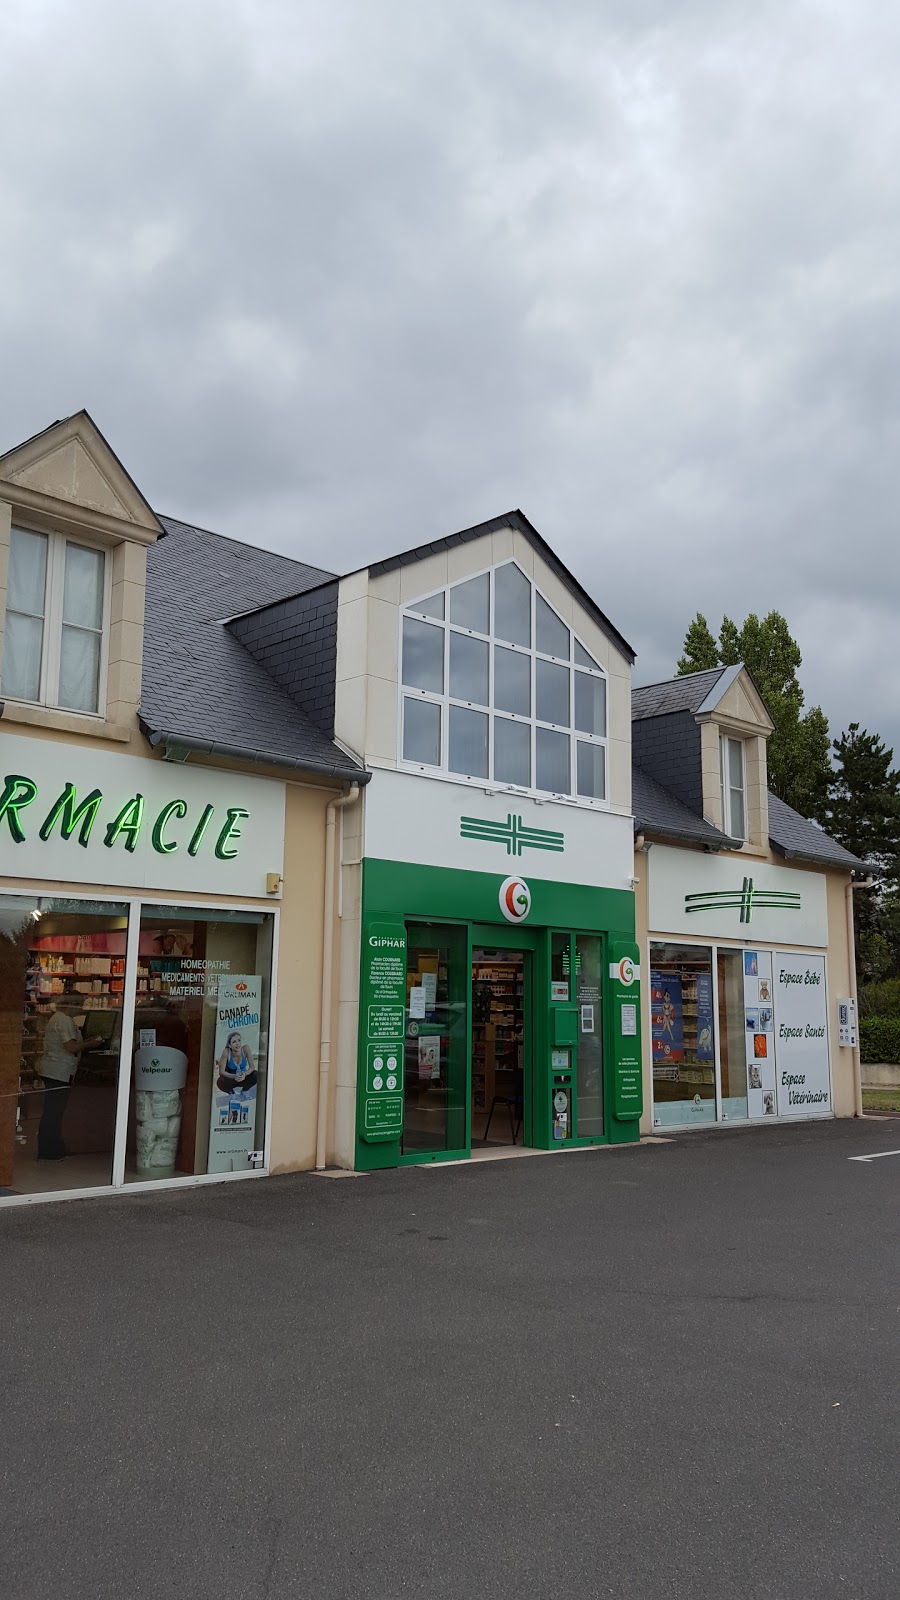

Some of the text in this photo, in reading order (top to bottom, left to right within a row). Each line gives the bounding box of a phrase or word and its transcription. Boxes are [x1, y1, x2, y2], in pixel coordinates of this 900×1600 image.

[0, 775, 250, 860] RMACIE
[369, 936, 405, 948] GIPHAR
[181, 959, 230, 970] HOMEOPATHIE
[162, 972, 205, 982] MEDICAMENTS
[780, 970, 802, 988] Espace
[170, 986, 205, 996] MATERIEL
[219, 1004, 250, 1020] CANAPÉ
[228, 1013, 259, 1029] CHRONO
[780, 1024, 826, 1042] Espace Santé
[782, 1072, 805, 1090] Espace
[788, 1090, 828, 1105] Vétérinaire
